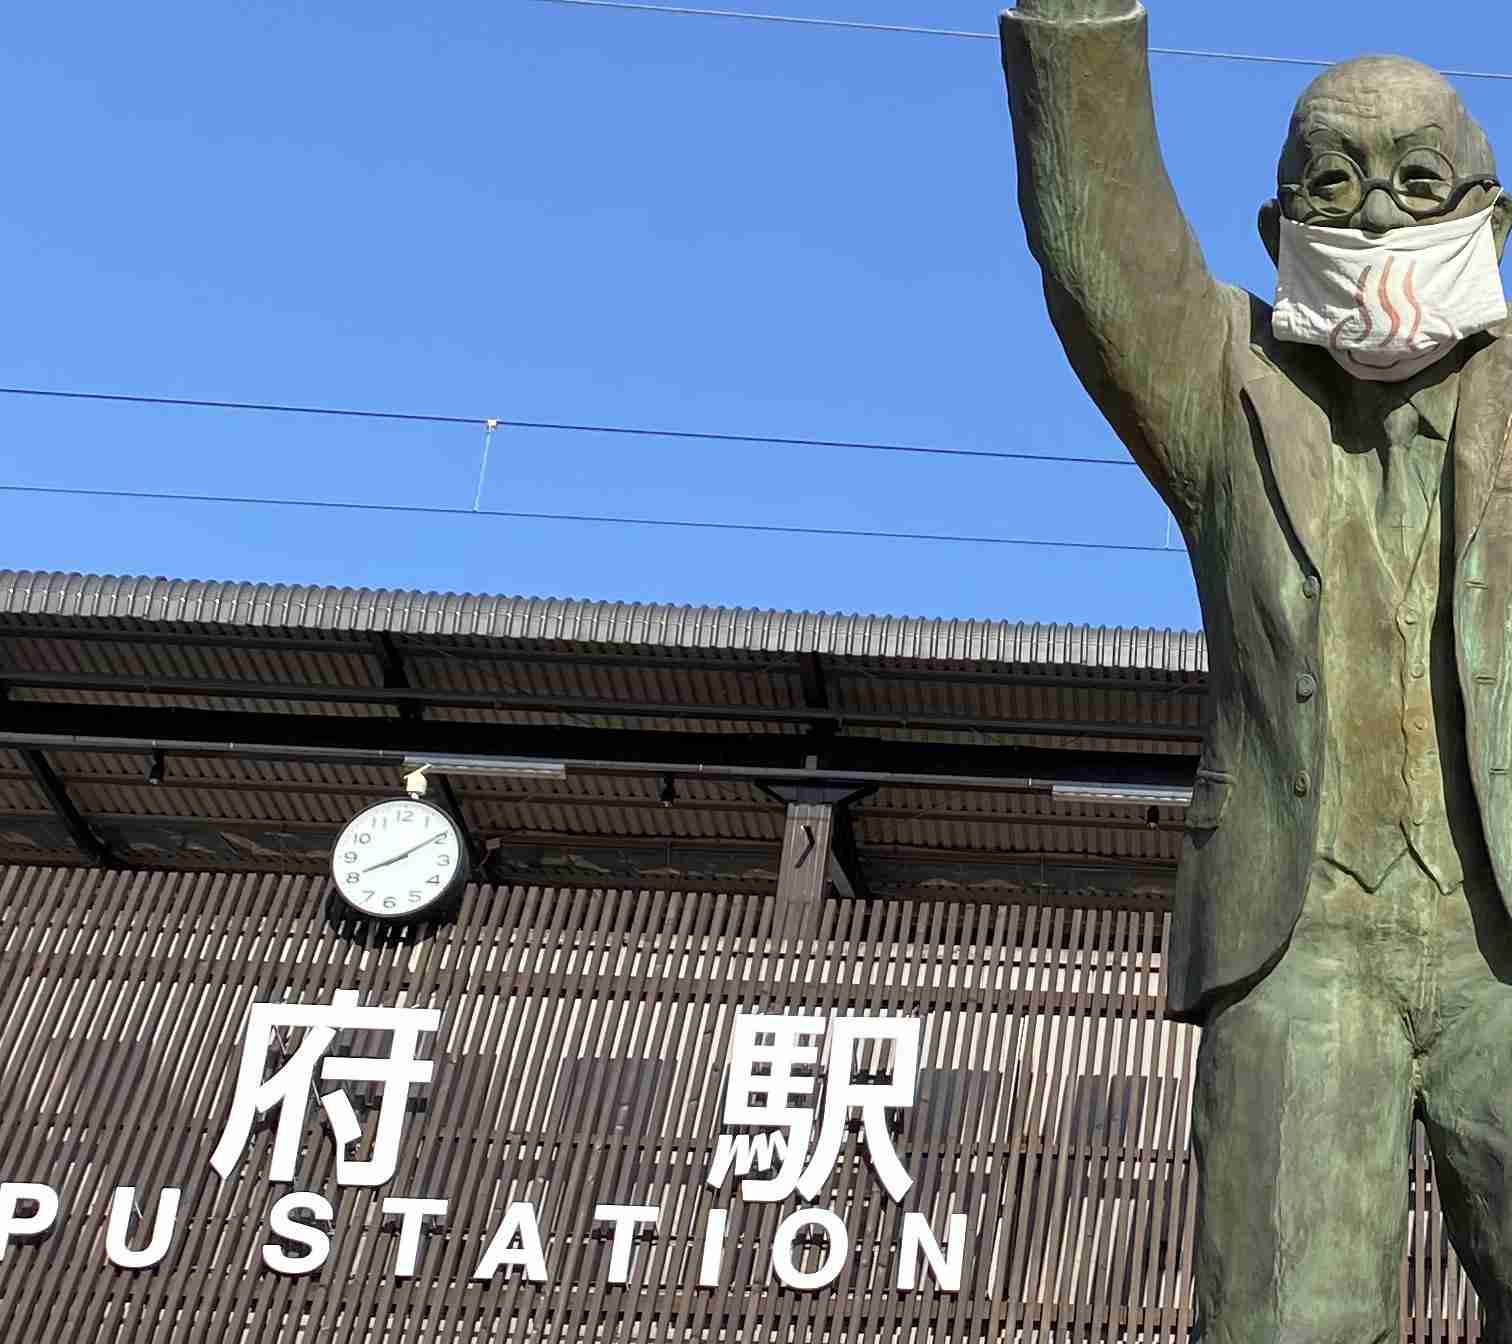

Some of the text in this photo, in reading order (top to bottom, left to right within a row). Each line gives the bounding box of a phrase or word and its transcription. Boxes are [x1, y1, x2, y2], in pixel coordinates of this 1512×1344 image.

[397, 810, 414, 822] 12
[424, 816, 430, 828] 1
[371, 816, 387, 830] 11
[353, 833, 372, 844] 10
[344, 851, 358, 863] 9
[437, 855, 450, 866] 3
[346, 872, 360, 884] 8
[426, 875, 440, 885] 4
[362, 890, 375, 902] 7
[409, 890, 422, 902] 5
[383, 897, 396, 908] 6
[0, 1183, 968, 1292] PU STATION
